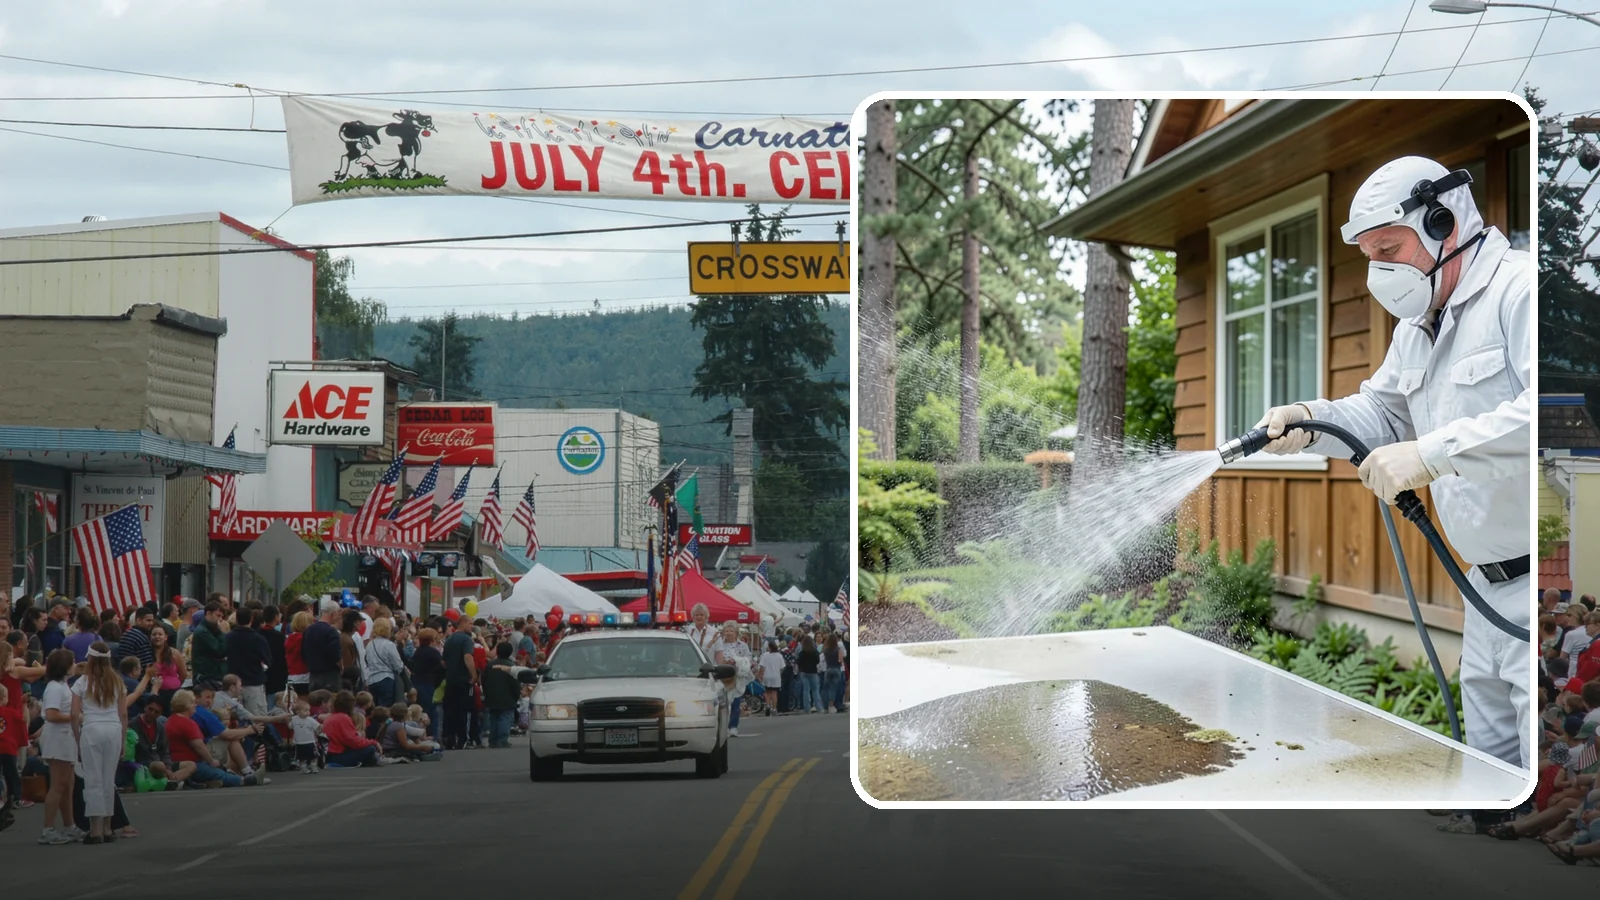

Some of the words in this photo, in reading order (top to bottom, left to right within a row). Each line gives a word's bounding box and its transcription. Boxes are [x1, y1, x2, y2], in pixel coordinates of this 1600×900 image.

[695, 121, 850, 149] Carnat
[481, 141, 605, 192] JULY
[632, 150, 747, 197] 4th.
[697, 254, 850, 280] CROSSWA
[282, 380, 374, 420] ACE
[406, 409, 453, 422] CEDAR
[283, 421, 371, 436] Hardware
[353, 467, 387, 480] Simpl
[96, 485, 124, 495] Vincent
[126, 486, 136, 494] de
[138, 486, 155, 495] Paul
[688, 526, 741, 535] CRNATION
[699, 535, 730, 543] GLASS
